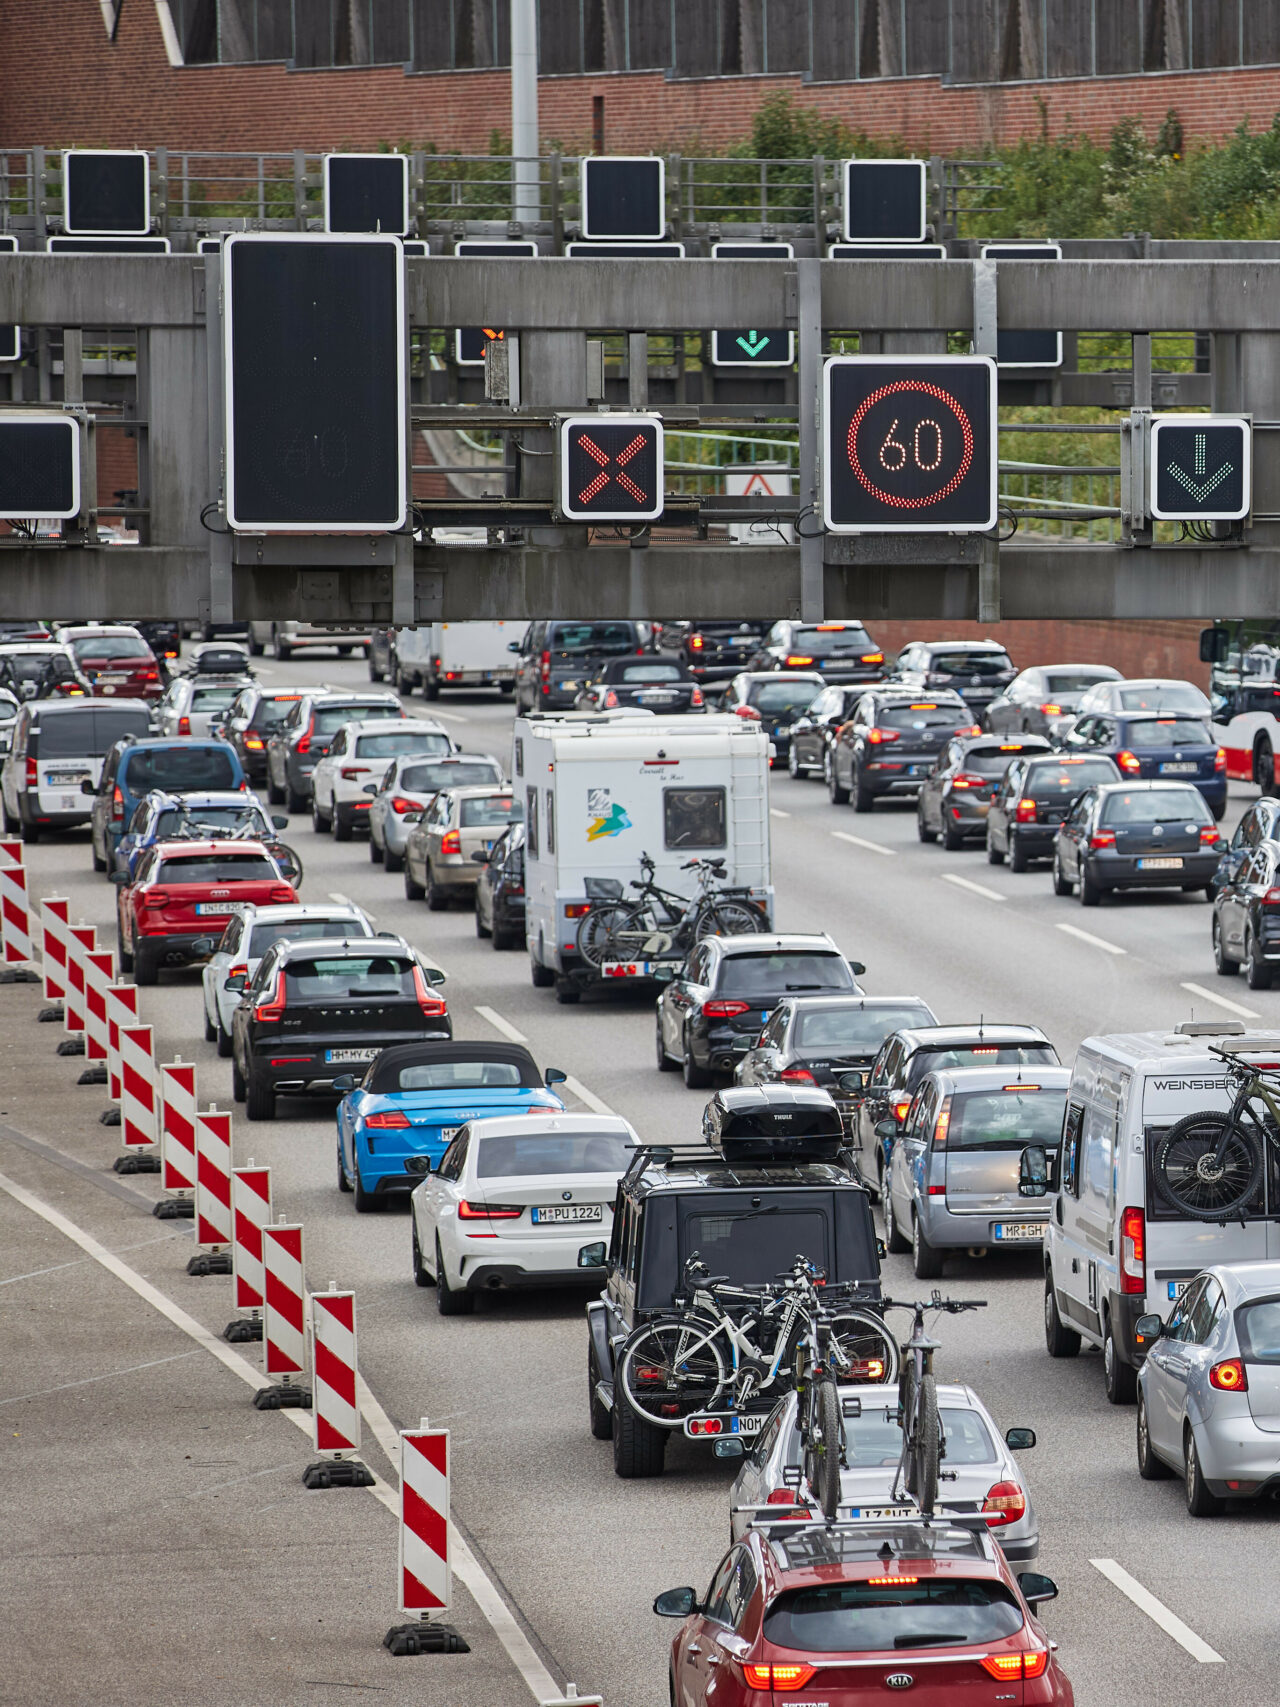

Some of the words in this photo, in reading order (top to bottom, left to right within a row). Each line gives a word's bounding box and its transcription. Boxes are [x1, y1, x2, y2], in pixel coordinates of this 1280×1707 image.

[879, 418, 943, 471] 60
[331, 1051, 344, 1061] HH
[350, 1050, 362, 1060] MY
[443, 1128, 450, 1138] M
[539, 1209, 547, 1220] M
[554, 1208, 570, 1220] PU
[572, 1207, 601, 1219] 1224
[1006, 1227, 1020, 1238] MR
[1027, 1225, 1042, 1237] GH
[739, 1417, 762, 1431] NOM
[890, 1675, 910, 1686] KIA
